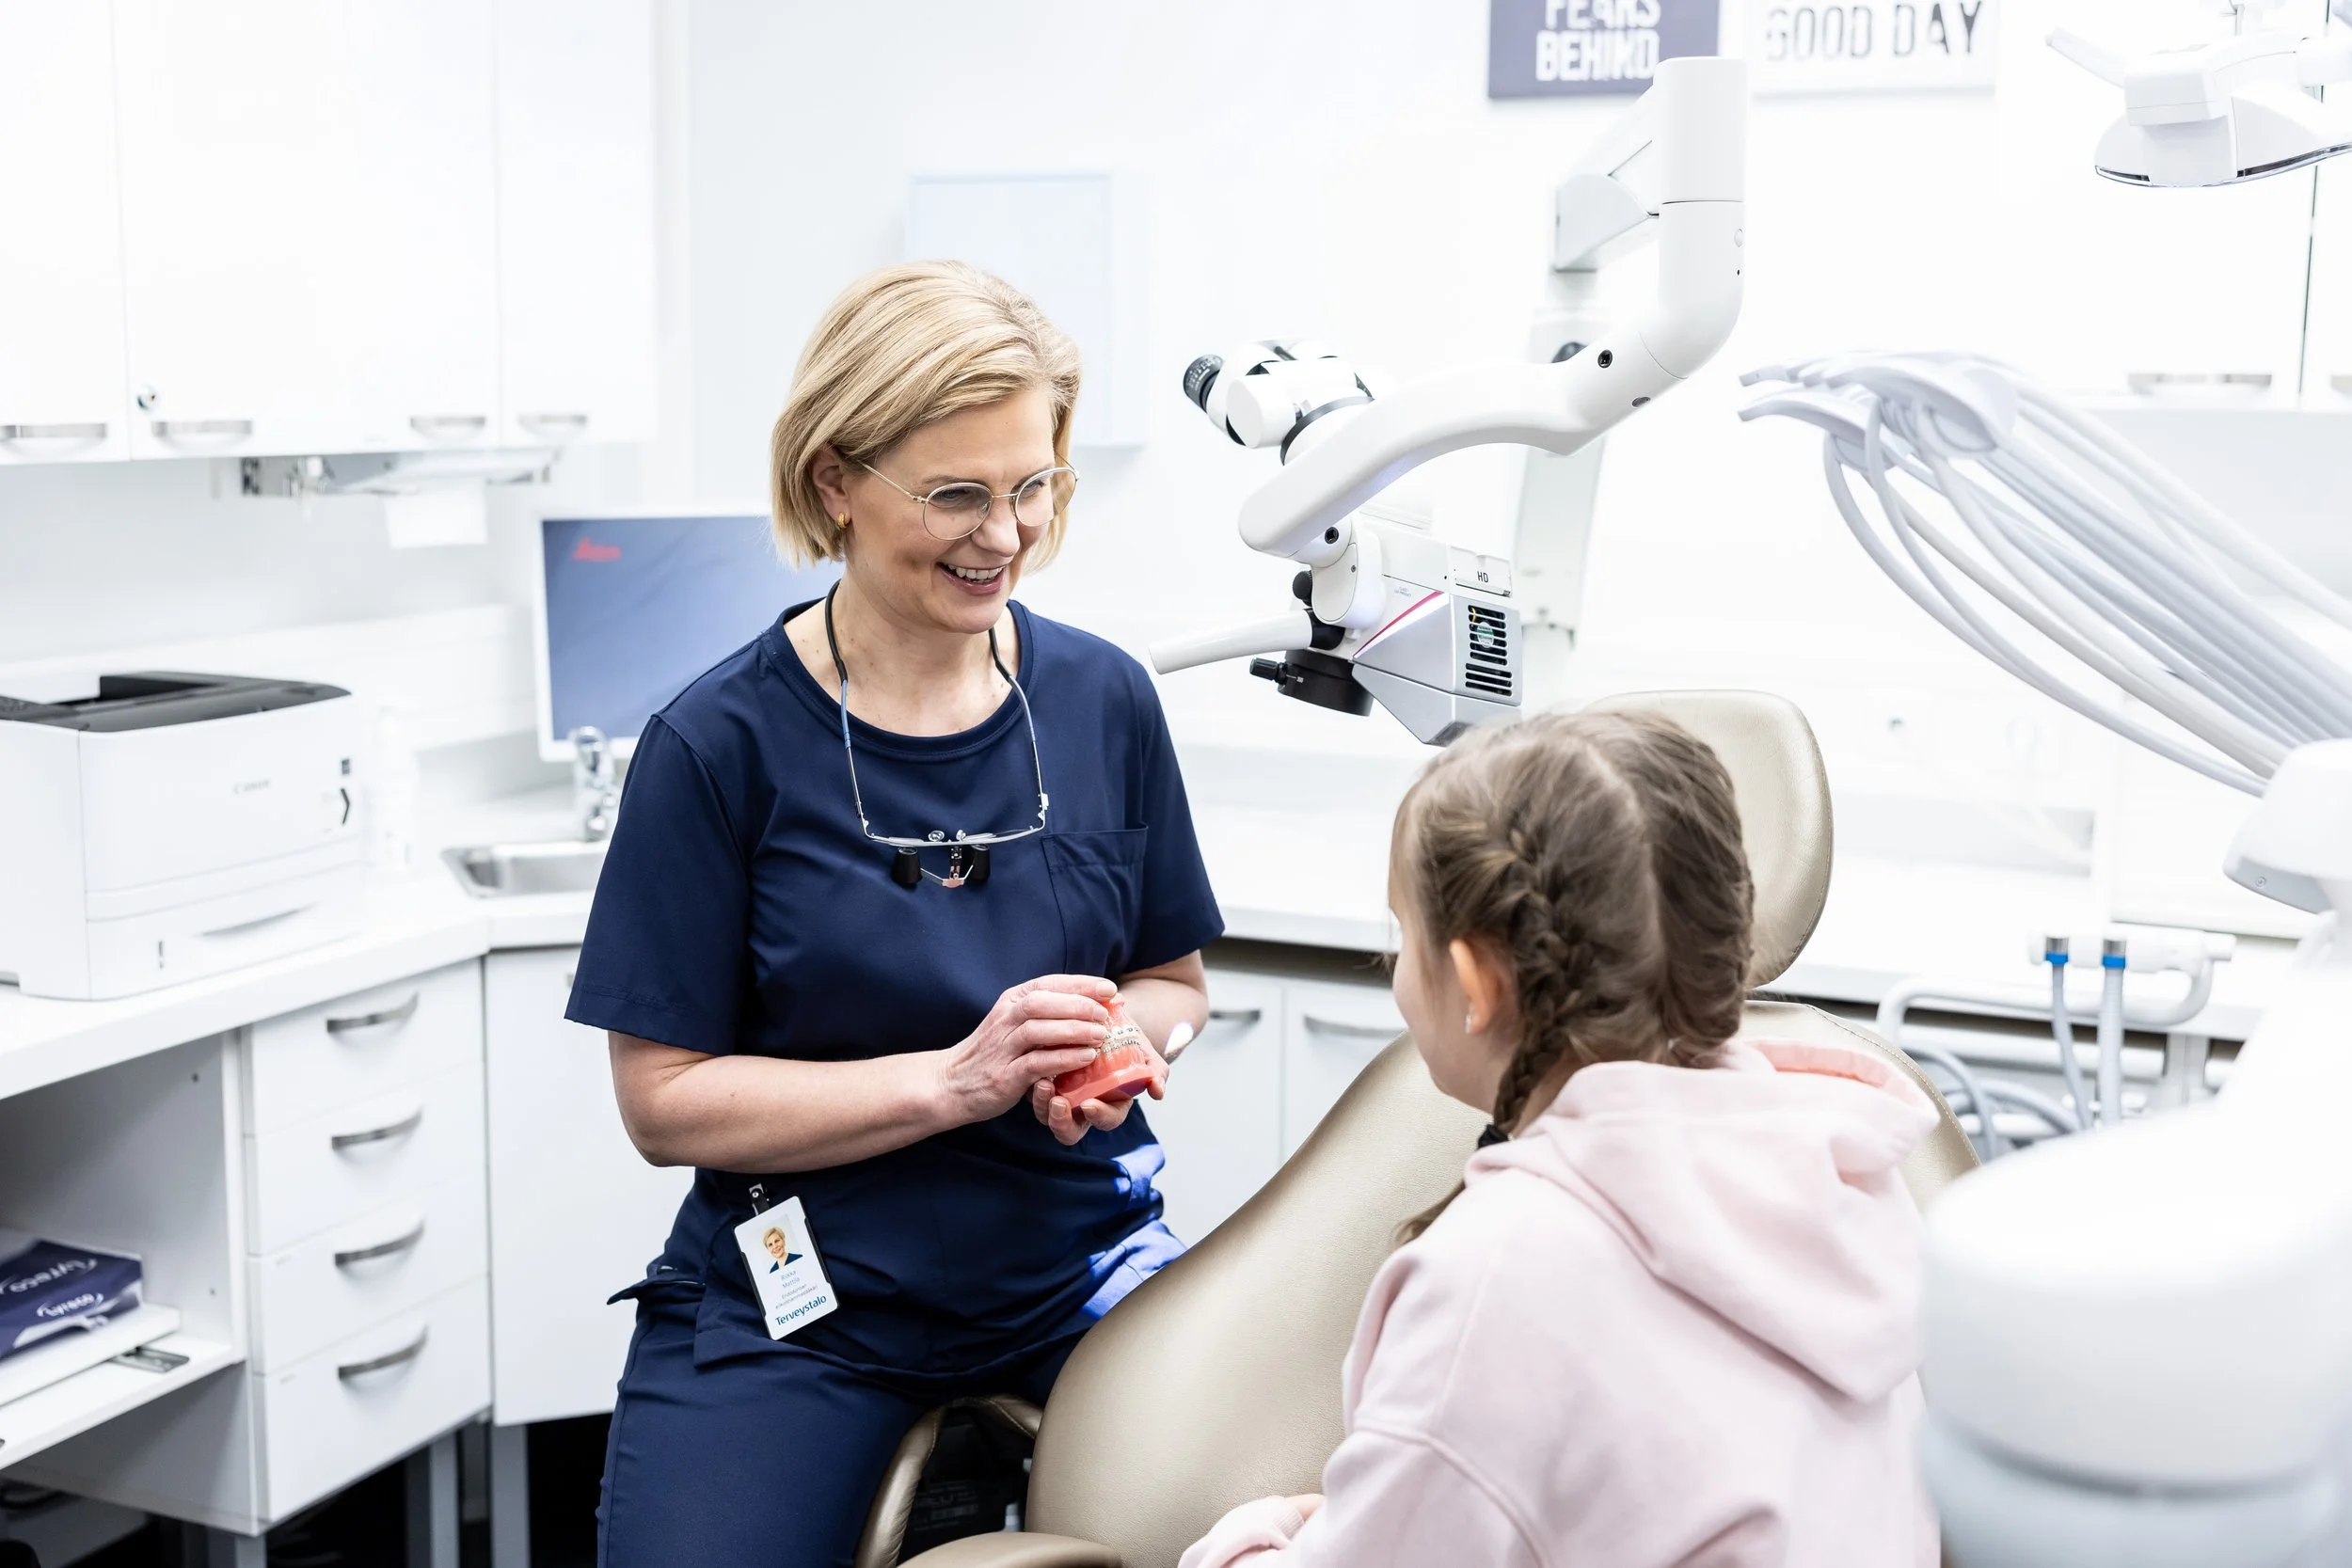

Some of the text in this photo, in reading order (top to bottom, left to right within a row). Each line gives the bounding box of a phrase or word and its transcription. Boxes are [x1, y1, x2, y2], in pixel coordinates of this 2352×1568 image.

[1766, 1, 1982, 61] GOOD DAY
[1535, 28, 1660, 82] BEHIND
[1477, 571, 1488, 583] HD
[775, 1295, 827, 1325] Terveystalo
